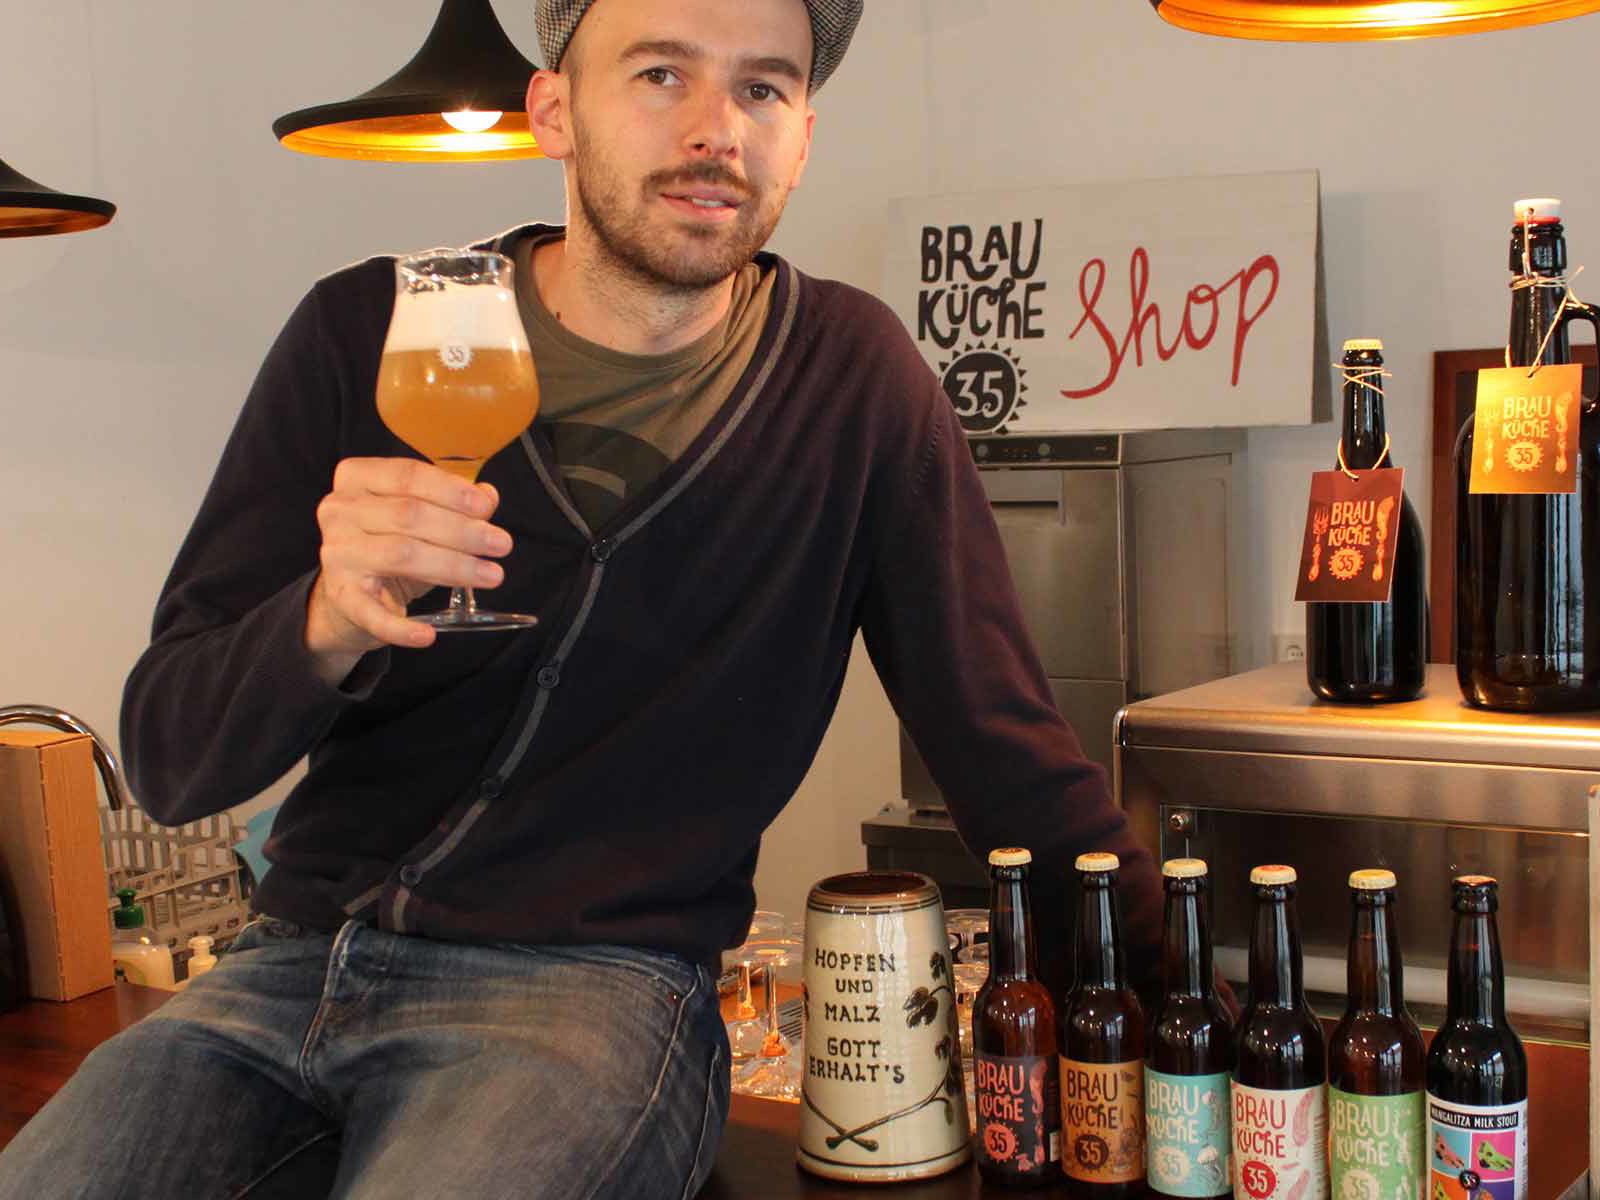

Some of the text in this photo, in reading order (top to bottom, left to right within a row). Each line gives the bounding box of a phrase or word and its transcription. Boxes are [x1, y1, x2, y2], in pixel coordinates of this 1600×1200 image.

[920, 218, 1044, 283] BRAU
[1060, 246, 1280, 399] Shop
[955, 370, 1004, 419] 35
[1503, 395, 1552, 419] BRAU
[1514, 448, 1533, 465] 35
[1330, 501, 1375, 525] BRAU
[1337, 554, 1353, 571] 35
[815, 948, 896, 973] HOPFEN
[836, 978, 873, 993] UND
[824, 1003, 880, 1023] MALZ
[827, 1037, 880, 1058] GOTT
[809, 1055, 905, 1084] ERHALT'S
[978, 1060, 1025, 1095] BRAU
[1067, 1069, 1118, 1101] BRAU
[1149, 1080, 1200, 1115] BRAU
[1236, 1092, 1286, 1129] BRAU
[1336, 1099, 1389, 1136] BRAU
[1474, 1115, 1494, 1128] MILK
[1497, 1113, 1517, 1127] STOUT
[990, 1130, 1007, 1153] 35
[1080, 1140, 1098, 1161] 35
[1247, 1167, 1268, 1192] 35
